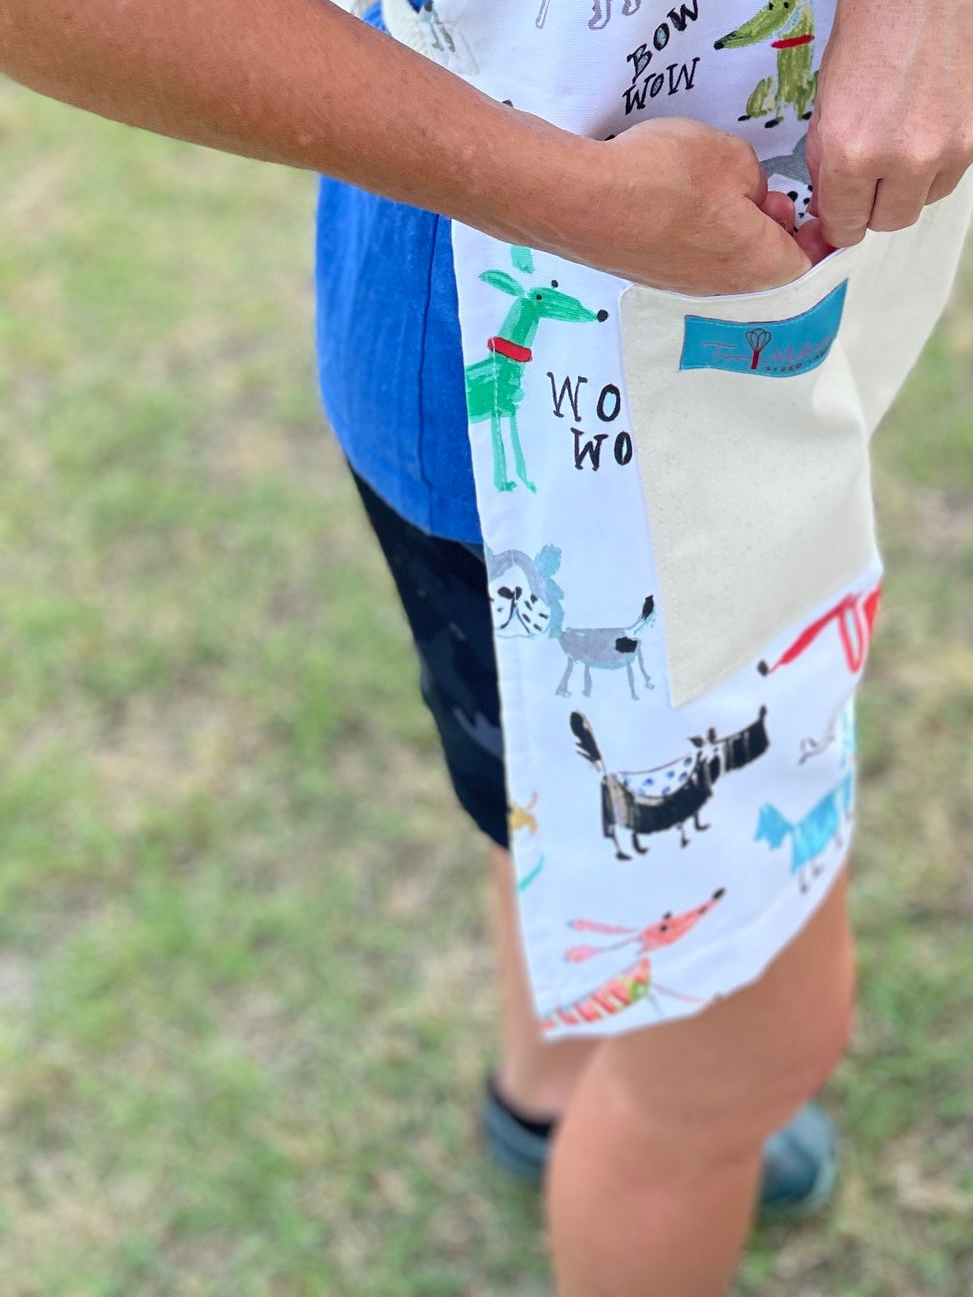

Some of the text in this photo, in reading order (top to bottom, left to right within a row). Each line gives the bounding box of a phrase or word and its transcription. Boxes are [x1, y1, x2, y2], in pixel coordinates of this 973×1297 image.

[622, 57, 700, 115] WOW
[547, 372, 621, 422] WO
[570, 427, 633, 472] WO
